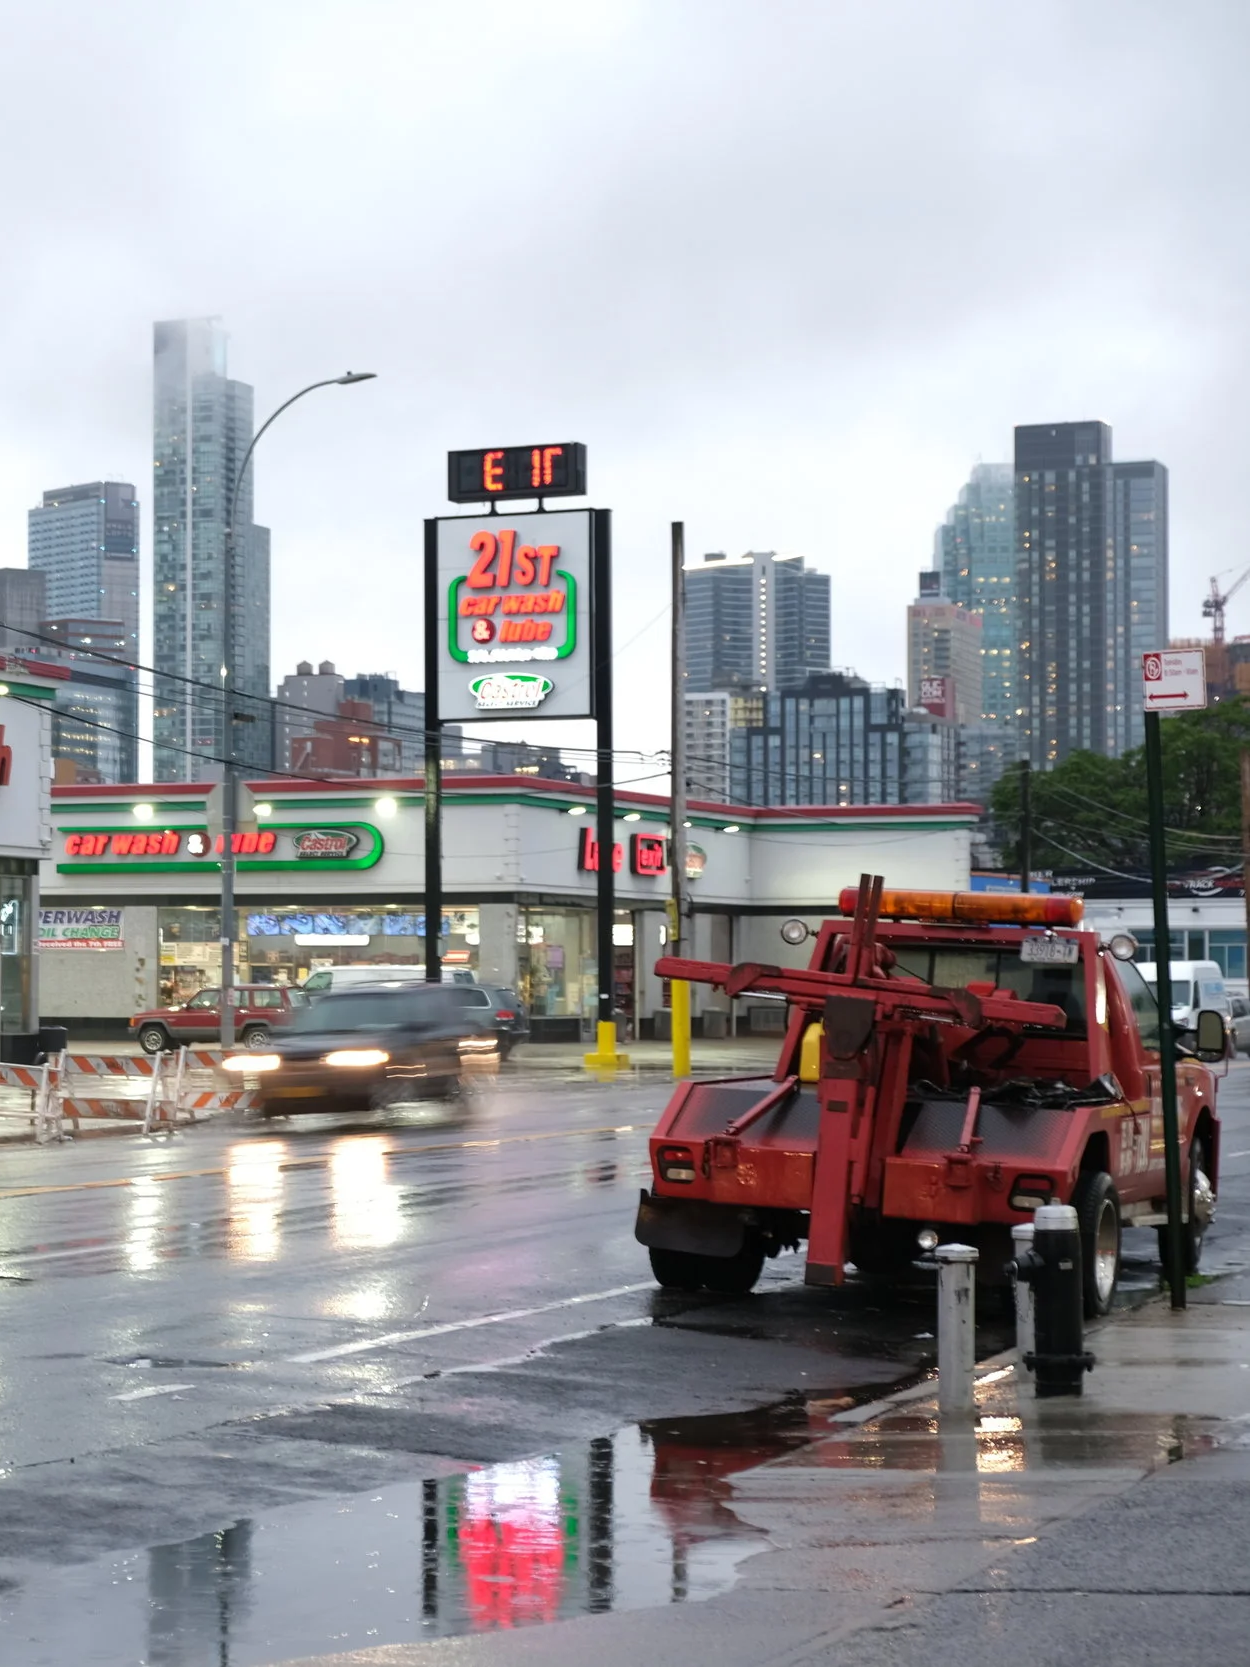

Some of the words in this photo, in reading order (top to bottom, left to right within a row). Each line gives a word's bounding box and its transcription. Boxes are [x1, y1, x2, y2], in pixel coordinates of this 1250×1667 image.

[466, 530, 559, 588] 21ST
[459, 595, 501, 616] car
[501, 589, 566, 615] wash
[473, 619, 491, 641] &
[498, 618, 553, 643] lube
[65, 834, 109, 856] car
[111, 830, 179, 855] wash
[300, 835, 348, 850] Castrol
[62, 927, 119, 938] CHANGE
